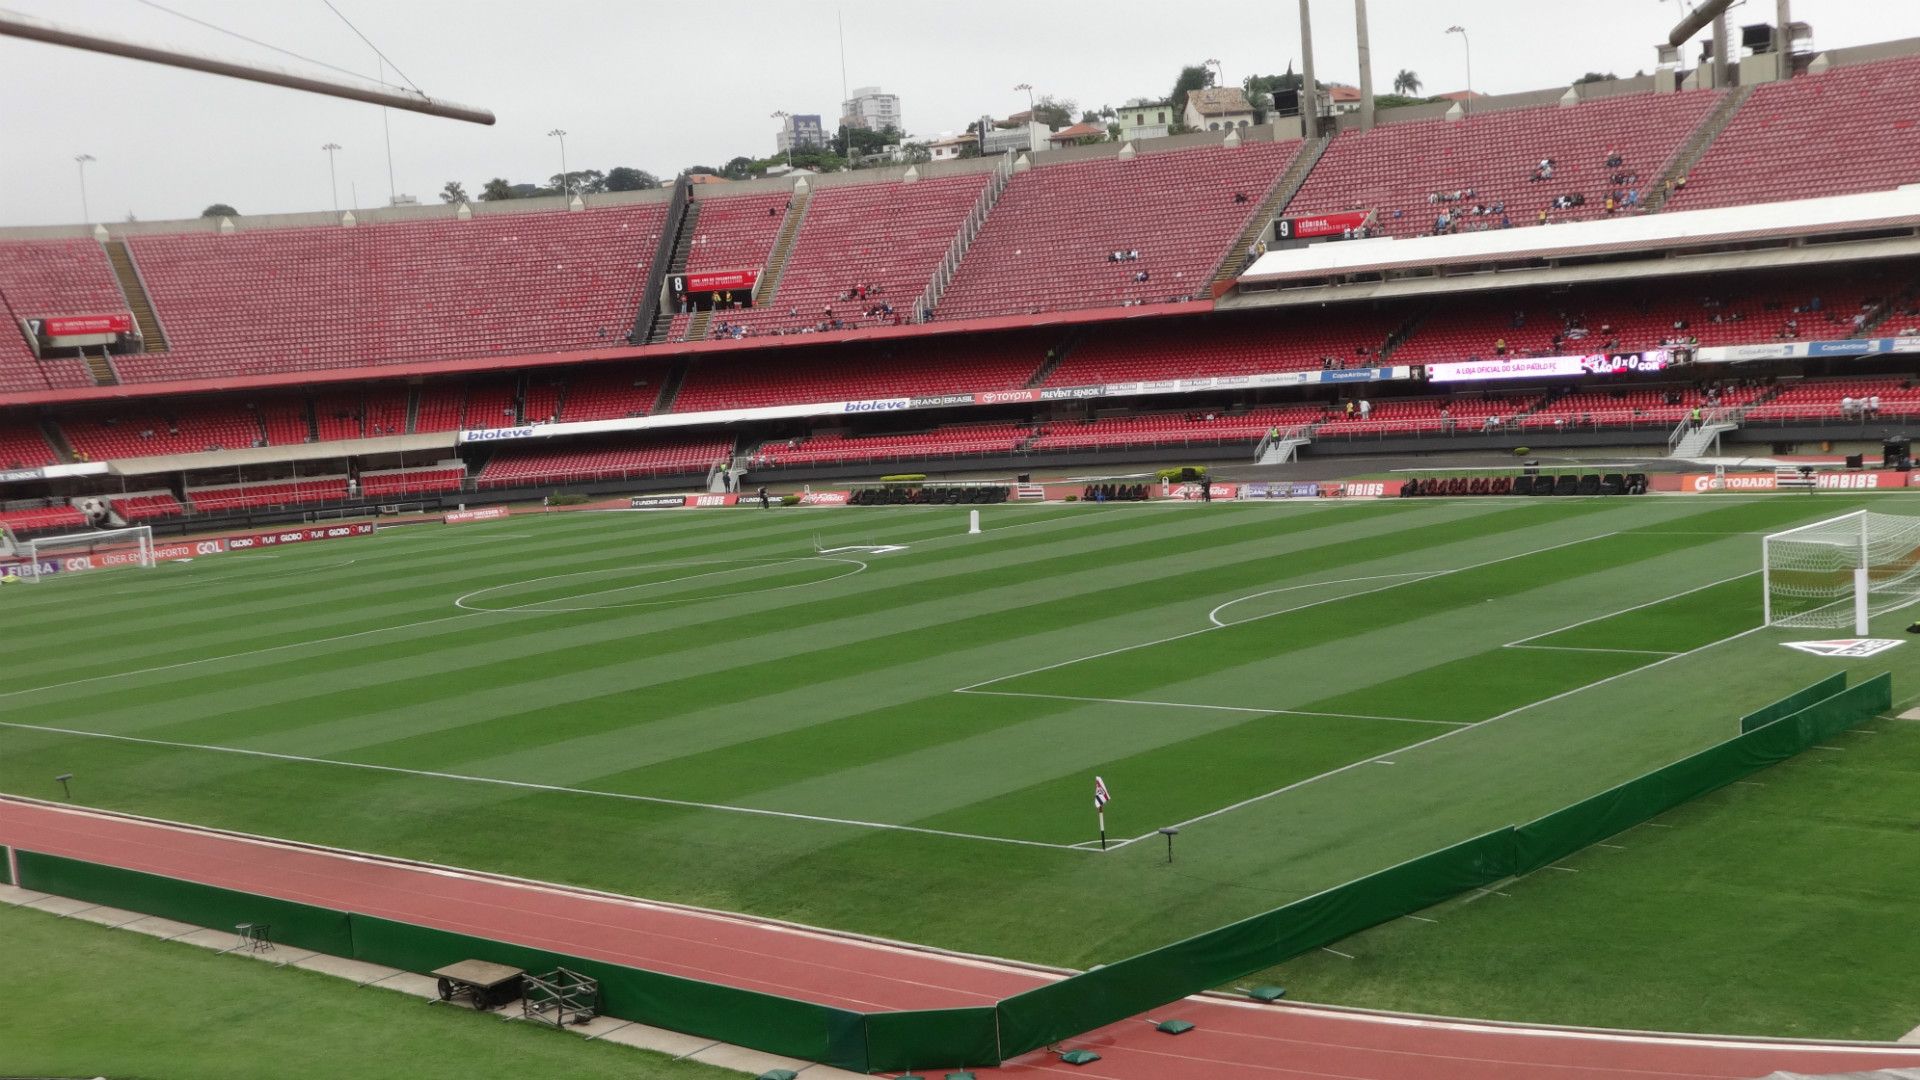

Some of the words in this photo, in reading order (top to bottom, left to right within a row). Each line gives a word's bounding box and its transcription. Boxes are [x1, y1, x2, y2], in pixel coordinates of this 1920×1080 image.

[1280, 221, 1289, 237] 9
[674, 277, 683, 291] 8
[30, 319, 40, 335] 7
[1477, 365, 1501, 373] OFICIAL
[1512, 362, 1526, 371] SÃO
[1526, 361, 1548, 370] PAULO
[1548, 361, 1558, 370] FC
[1612, 355, 1622, 369] 0
[1629, 355, 1639, 369] 0
[1638, 361, 1660, 371] COR
[998, 391, 1032, 401] TOYOTA
[1040, 388, 1071, 398] PREVENT
[1073, 386, 1098, 396] SENIOR
[845, 399, 906, 412] bioleve
[909, 397, 941, 408] GRAND
[944, 395, 975, 404] BRASIL
[467, 428, 533, 441] bioleve
[1709, 477, 1774, 489] GTORADE
[638, 499, 658, 507] UNDER
[658, 497, 684, 506] ARMOUR
[280, 533, 303, 542] GLOBO
[311, 531, 325, 539] PLAY
[329, 528, 350, 537] GLOBO
[359, 525, 372, 533] PLAY
[197, 540, 223, 555] GOL
[230, 538, 254, 548] GLOBO
[262, 535, 277, 544] PLAY
[66, 556, 95, 571] GOL
[129, 552, 141, 562] EM
[8, 560, 55, 577] FIBRA
